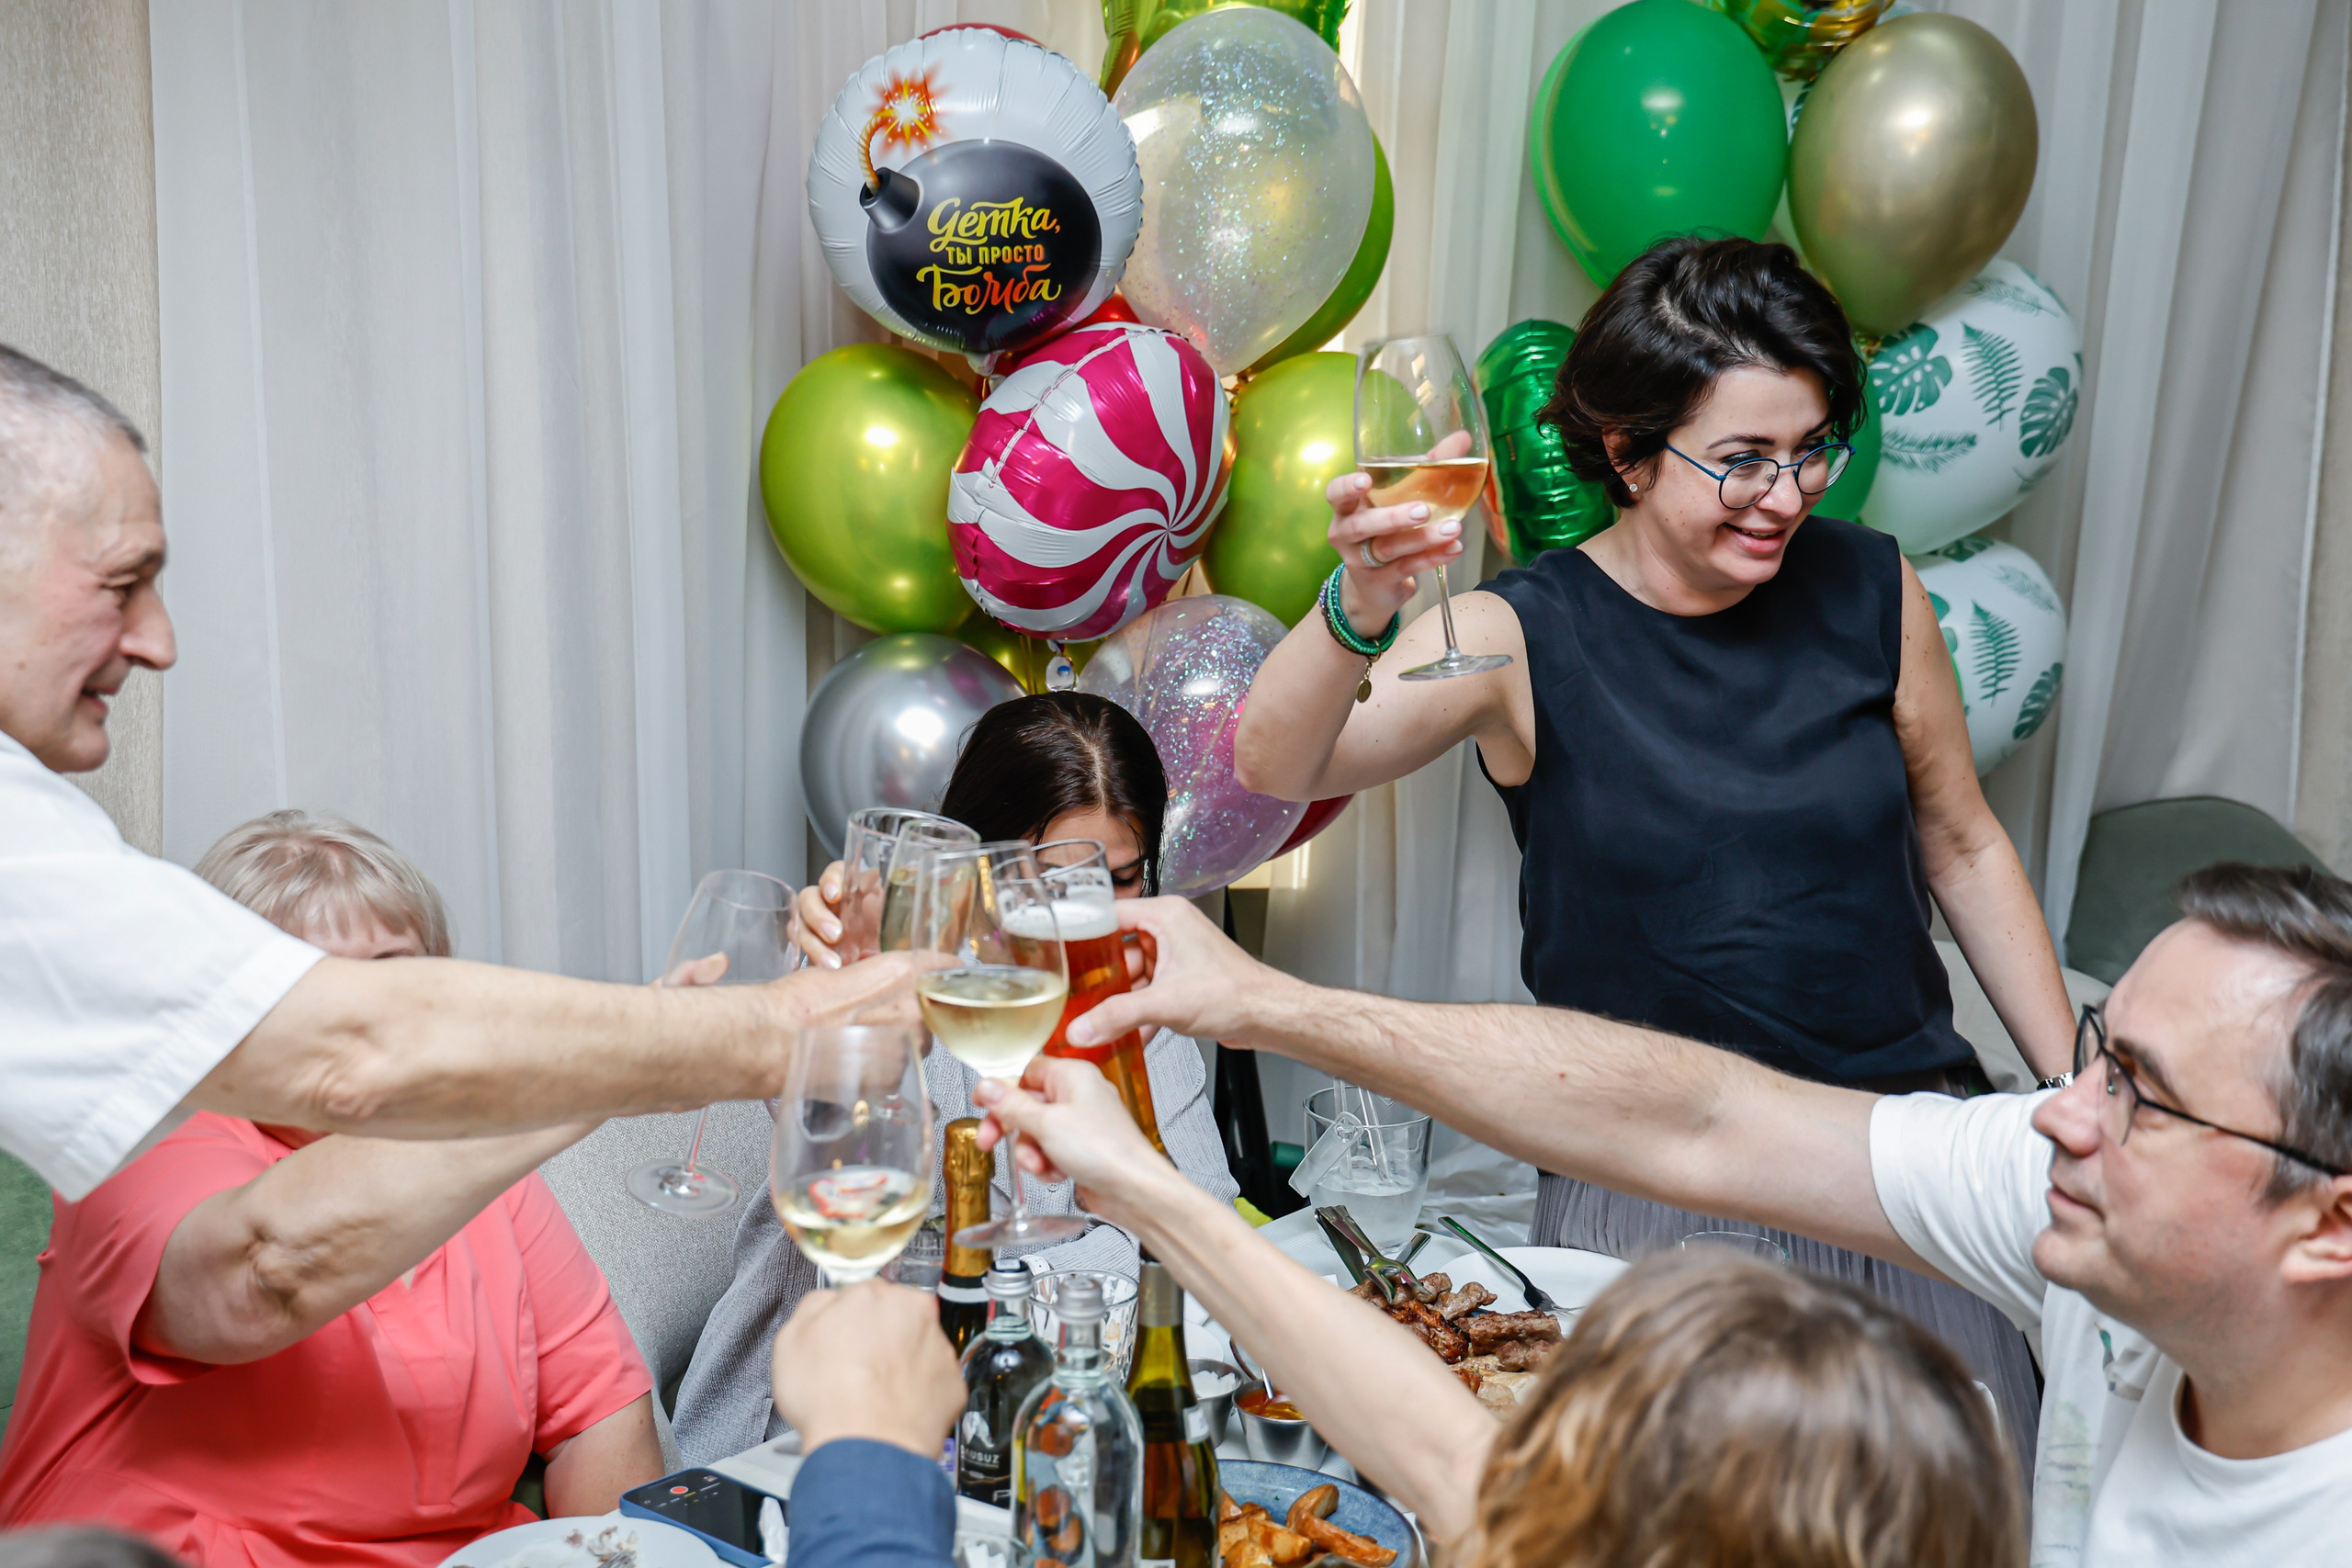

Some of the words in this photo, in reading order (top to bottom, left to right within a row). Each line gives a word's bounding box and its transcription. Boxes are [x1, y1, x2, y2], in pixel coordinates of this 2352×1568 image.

[927, 197, 1060, 253] Детка,
[945, 246, 972, 265] ТЫ
[978, 243, 1045, 265] ПРОСТО
[916, 263, 1061, 315] Бомба
